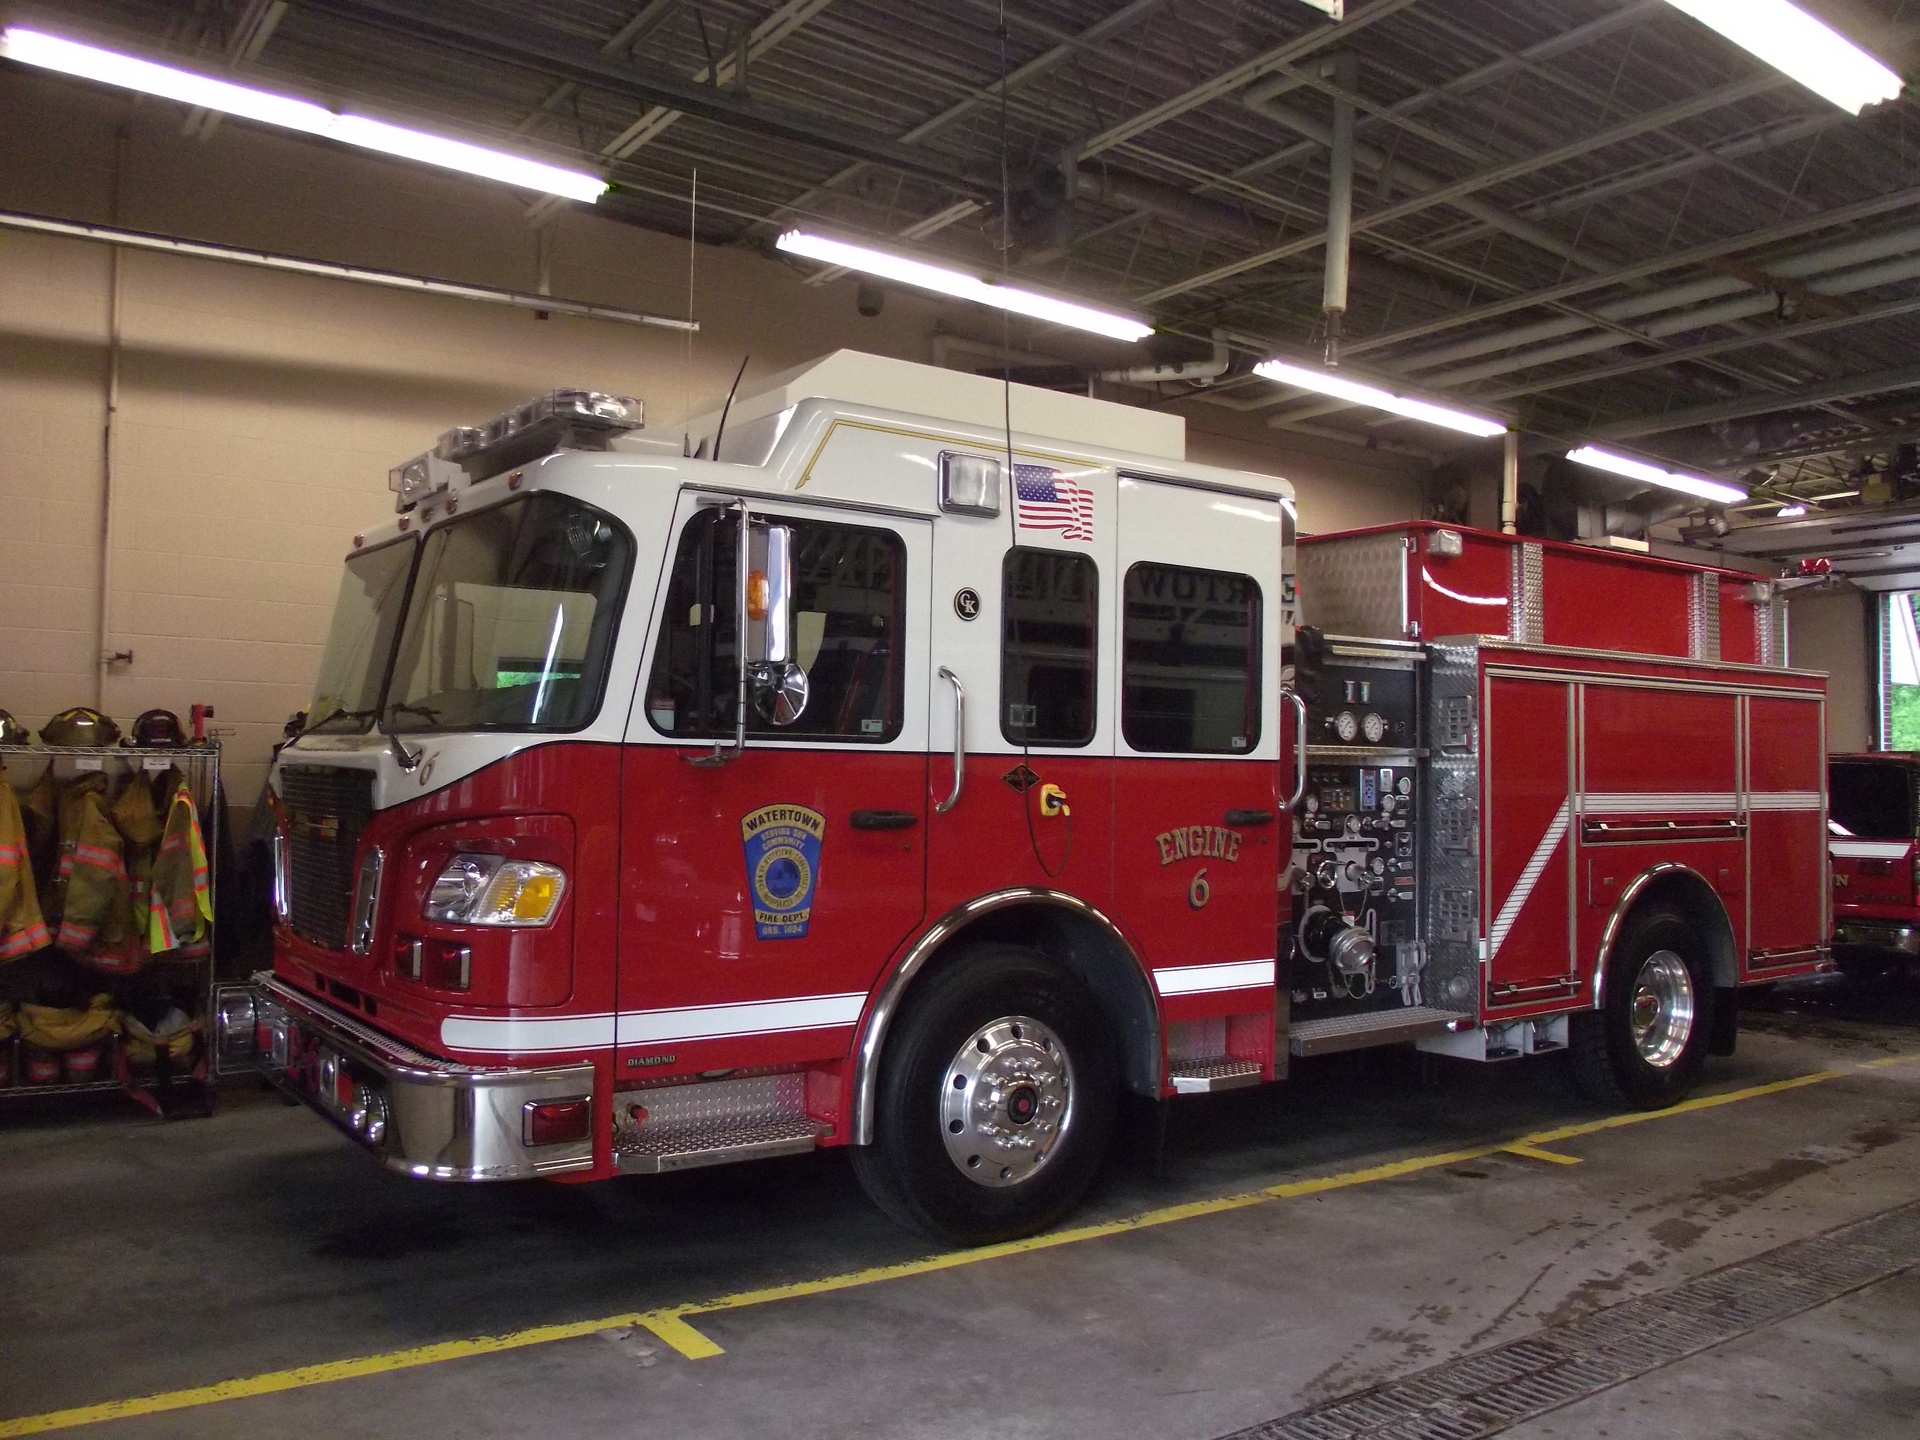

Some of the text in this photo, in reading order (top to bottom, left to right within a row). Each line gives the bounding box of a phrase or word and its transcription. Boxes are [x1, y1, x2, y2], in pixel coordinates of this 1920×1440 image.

[420, 750, 441, 786] 6
[746, 809, 821, 831] WATERTOWN
[1155, 825, 1242, 865] ENGINE
[1188, 867, 1210, 911] 6
[760, 912, 778, 923] FIRE
[627, 1055, 676, 1067] DIAMOND
